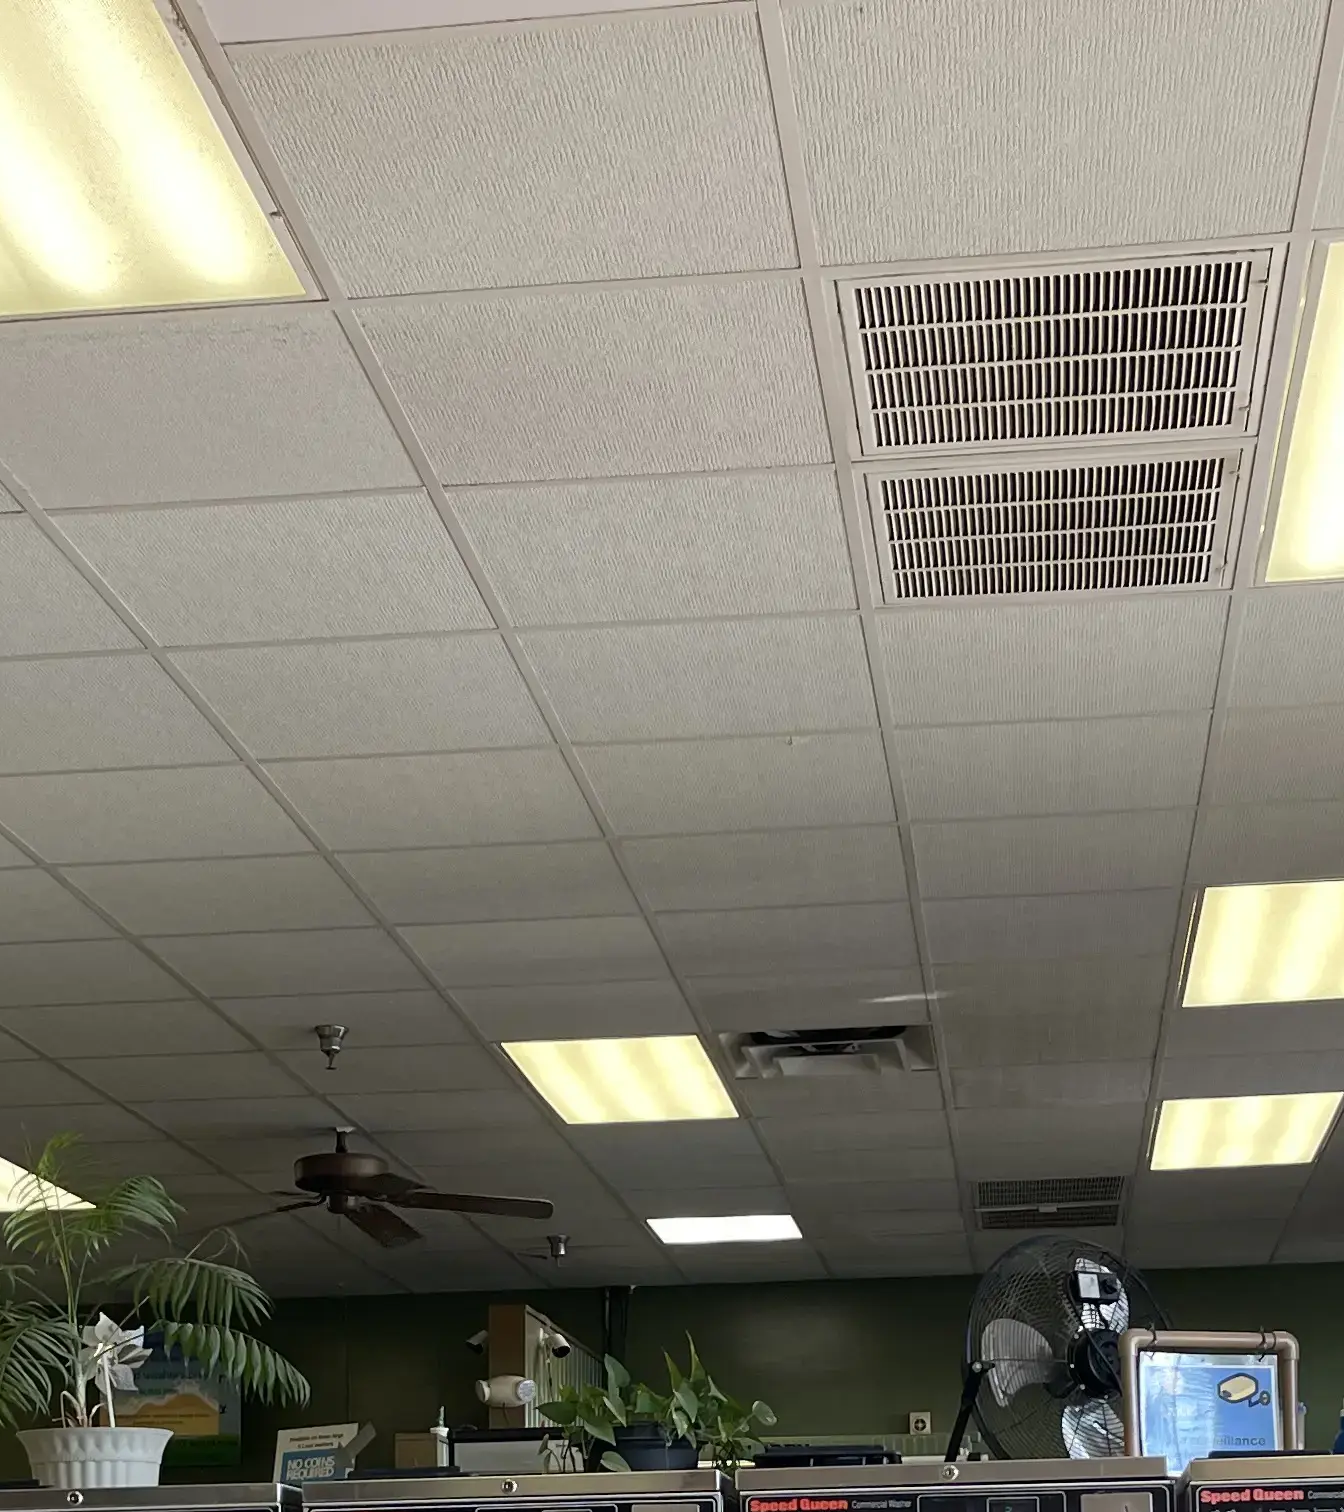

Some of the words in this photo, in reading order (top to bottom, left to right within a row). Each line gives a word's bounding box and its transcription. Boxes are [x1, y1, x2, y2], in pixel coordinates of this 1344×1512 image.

[288, 1458, 303, 1469] NO
[305, 1456, 335, 1468] COINS
[287, 1467, 335, 1480] REQUIRED
[1201, 1490, 1250, 1504] Speed
[1253, 1489, 1304, 1501] Queen
[800, 1498, 848, 1511] Queen
